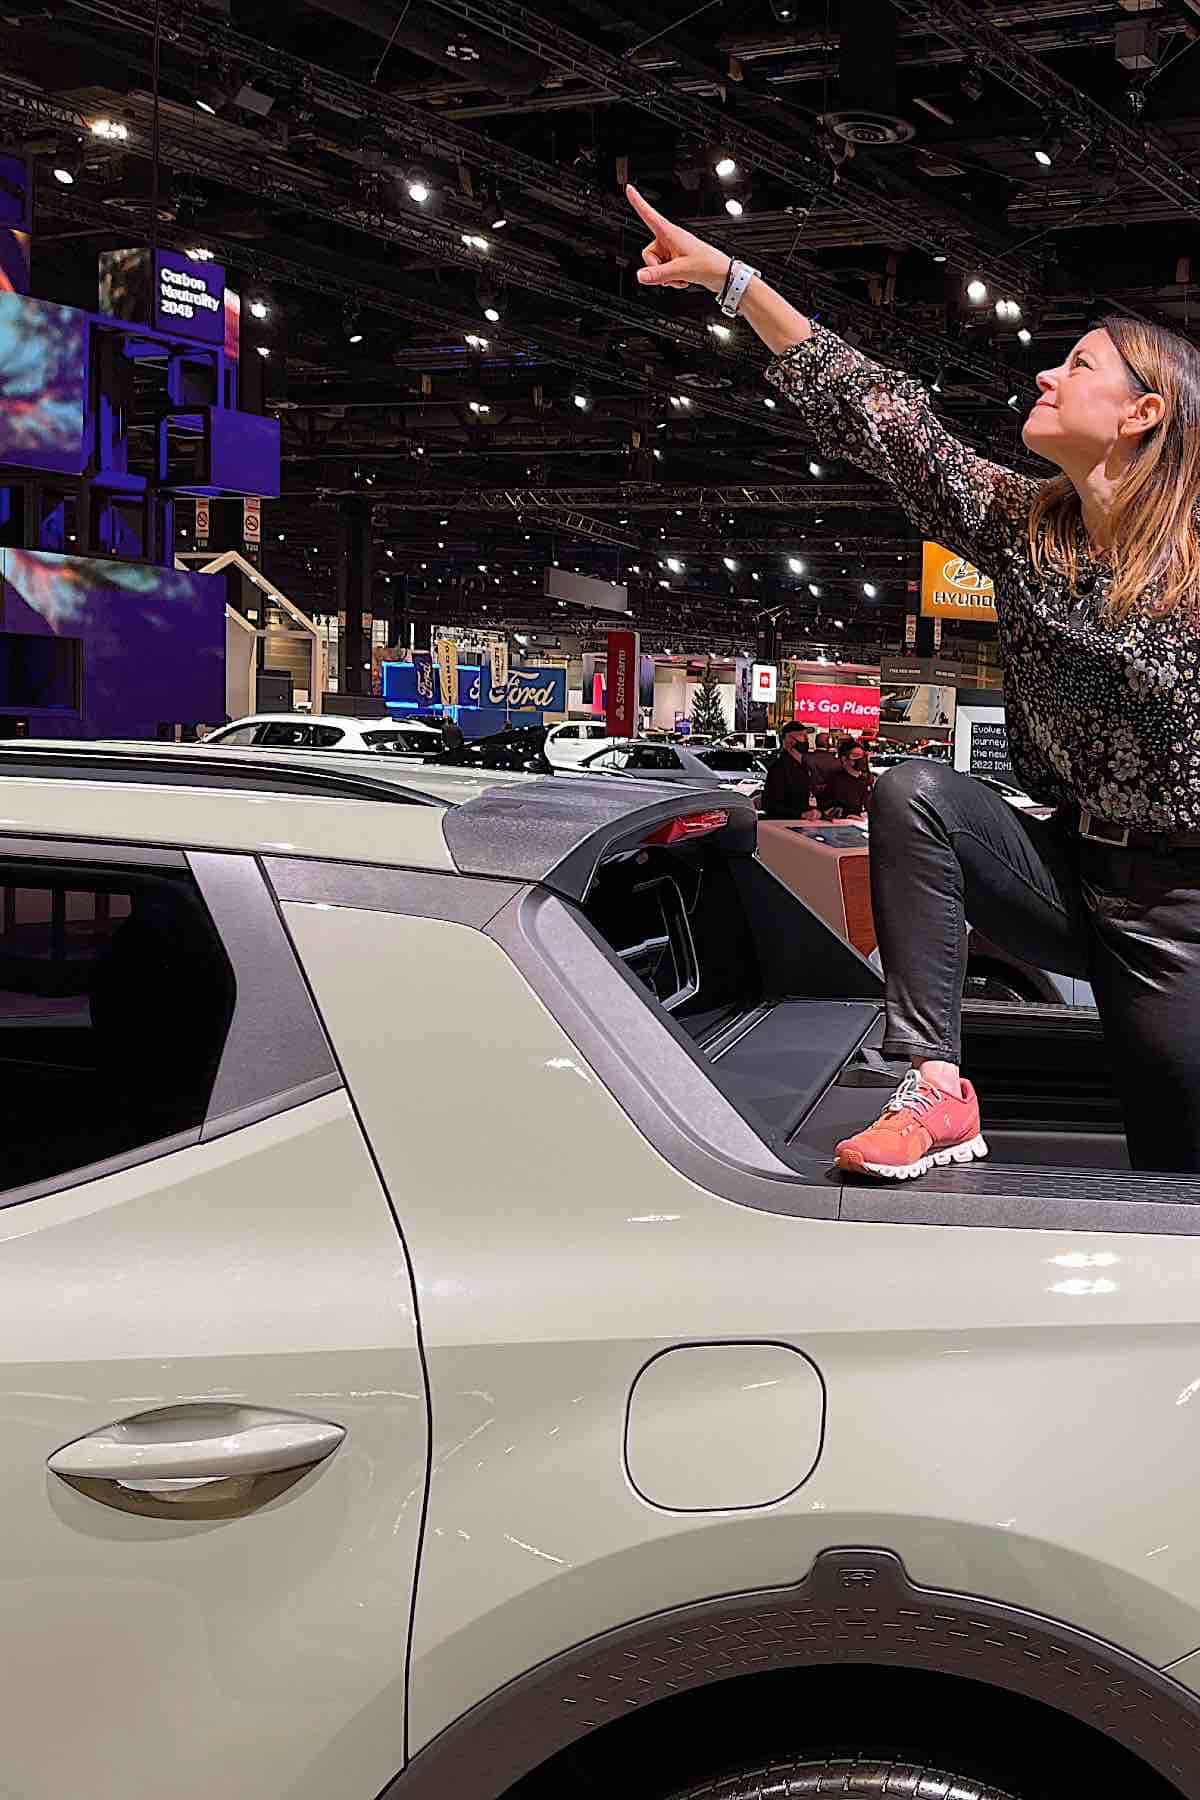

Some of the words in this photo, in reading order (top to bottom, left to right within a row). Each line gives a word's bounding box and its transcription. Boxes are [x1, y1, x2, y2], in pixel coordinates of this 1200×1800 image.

[161, 268, 206, 292] Carbon
[161, 283, 220, 312] Neutrality
[932, 591, 993, 608] HYUND
[417, 661, 433, 699] Ford
[488, 669, 556, 706] Ford
[818, 699, 840, 713] Go
[972, 724, 1002, 735] Evolve
[972, 735, 1006, 749] journey
[972, 749, 988, 758] the
[988, 751, 1007, 759] new
[971, 760, 993, 770] 2022
[994, 760, 1012, 771] IONI
